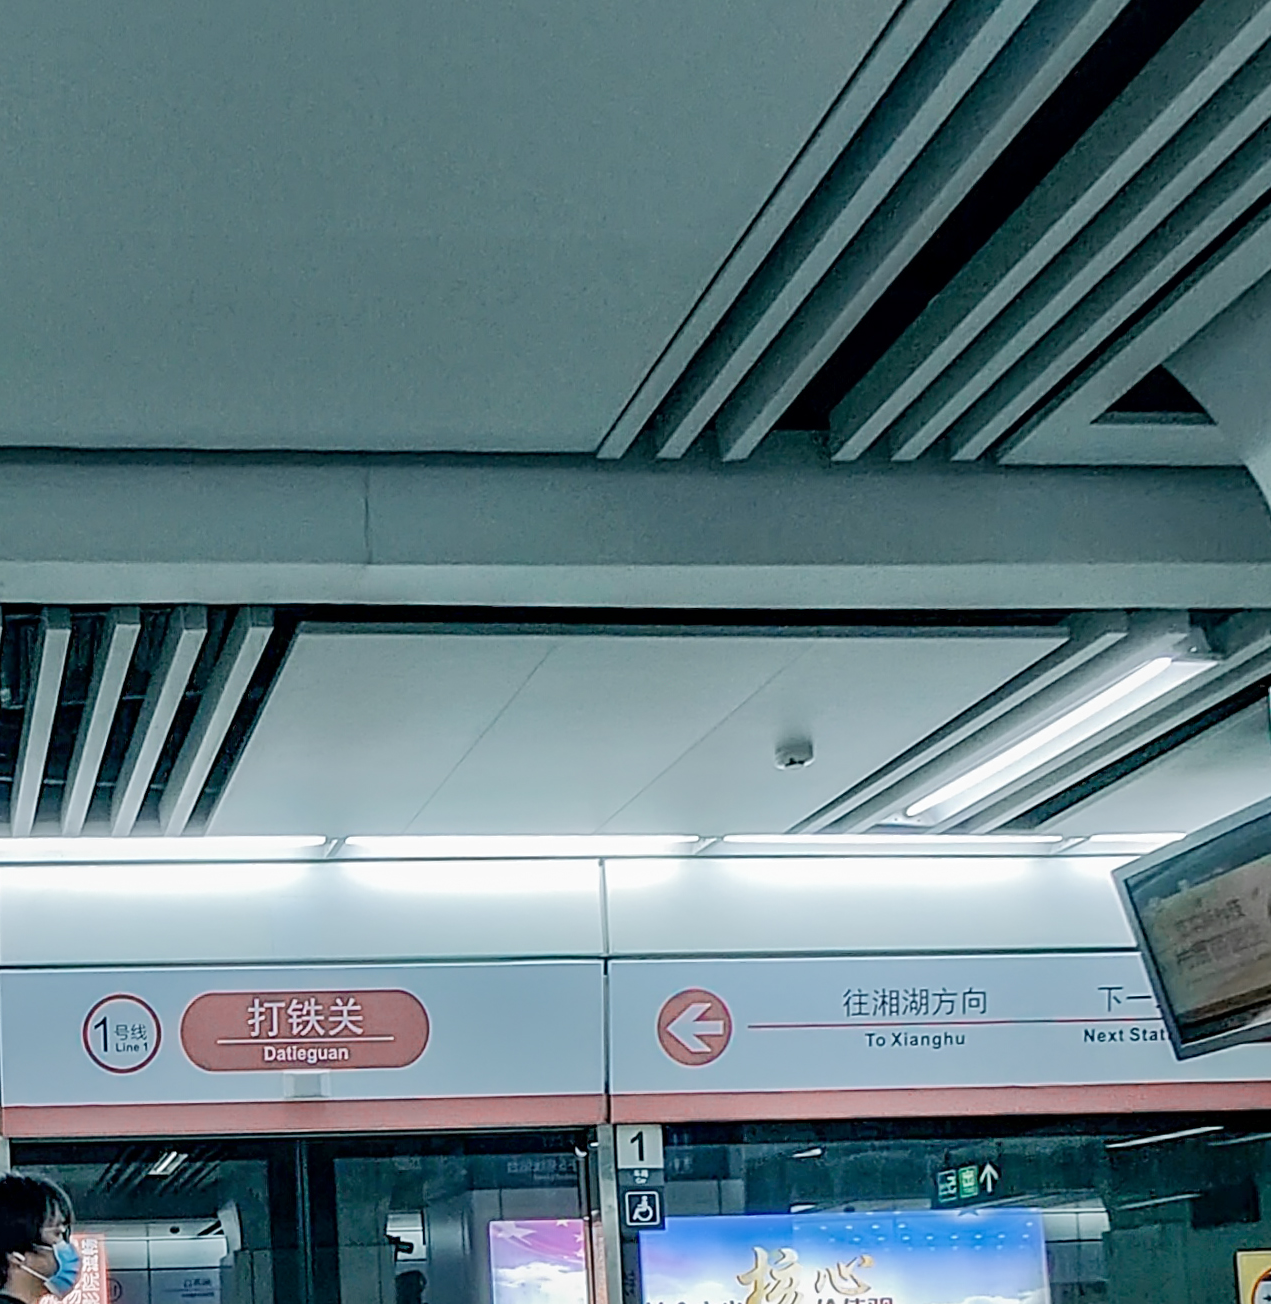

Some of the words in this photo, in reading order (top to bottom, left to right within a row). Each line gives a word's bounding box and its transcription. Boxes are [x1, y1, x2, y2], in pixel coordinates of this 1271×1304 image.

[842, 987, 987, 1018] 往湘湖方向
[1097, 986, 1161, 1013] 下一
[247, 996, 364, 1038] 打铁关
[865, 1033, 886, 1048] To
[891, 1032, 966, 1050] Xianghu
[1083, 1028, 1124, 1043] Next
[115, 1042, 140, 1053] Line
[143, 1042, 149, 1052] 1
[263, 1045, 349, 1064] Datieguan
[630, 1130, 644, 1162] 1
